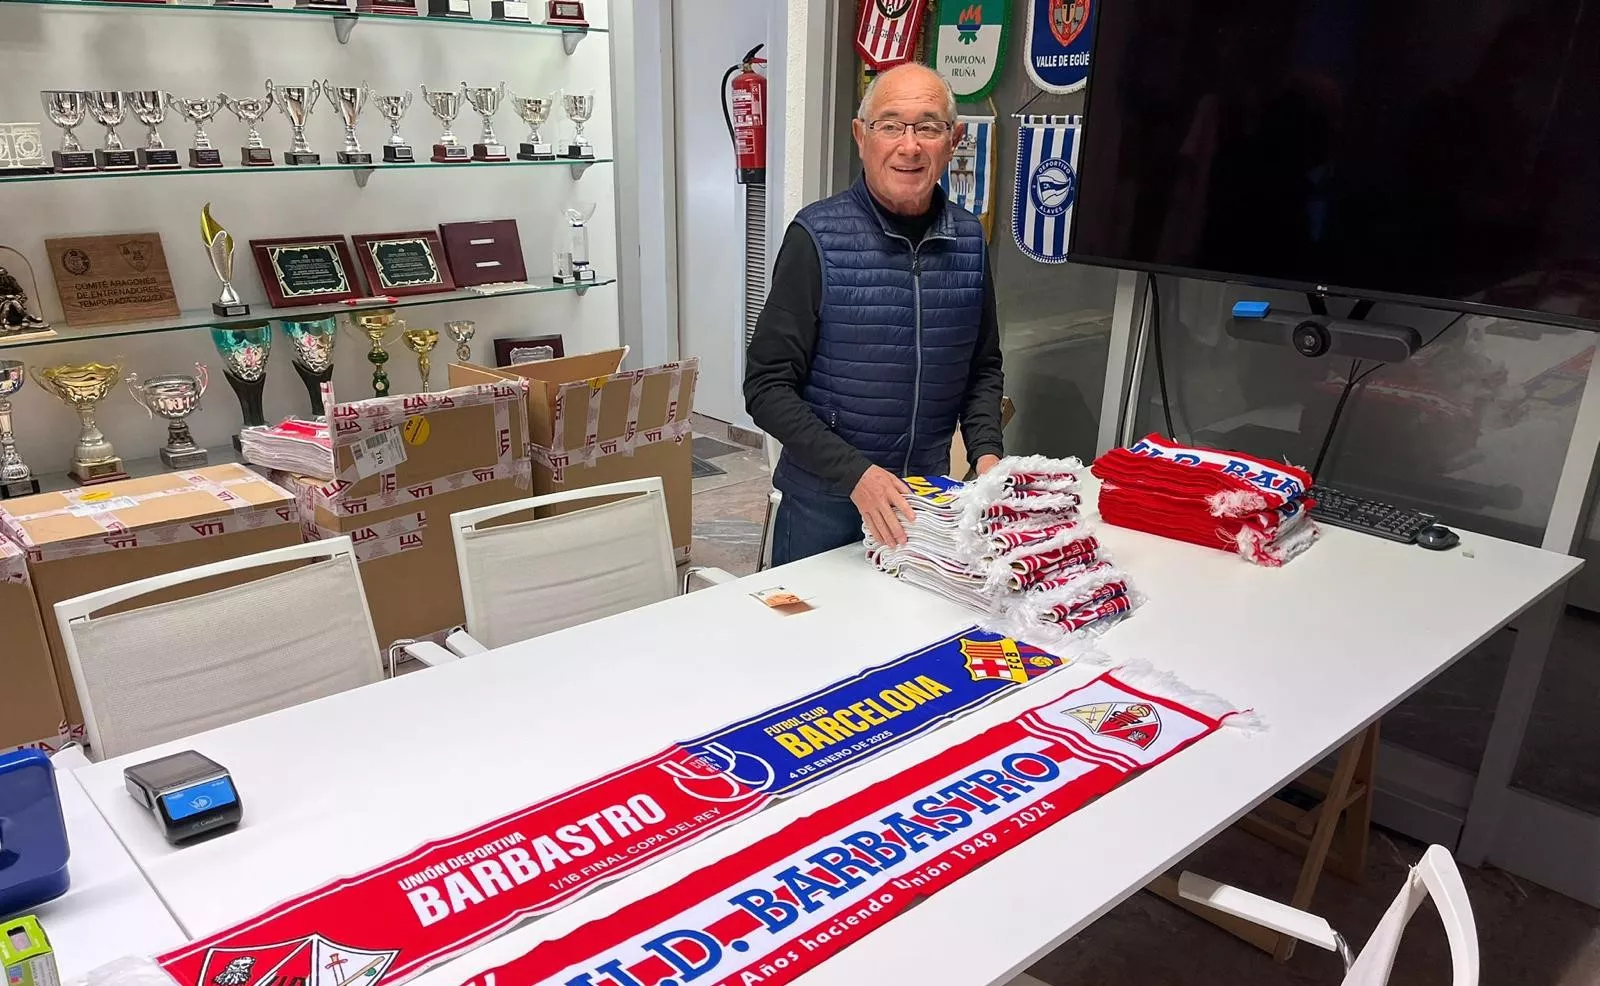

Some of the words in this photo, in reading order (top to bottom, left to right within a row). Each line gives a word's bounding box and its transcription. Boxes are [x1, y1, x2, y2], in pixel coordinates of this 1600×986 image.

[944, 55, 986, 65] PAMPLONA
[951, 66, 976, 78] IRUÑA
[1036, 55, 1057, 68] VALLE
[1058, 54, 1068, 67] DE
[1038, 160, 1071, 174] DEPORTIVO
[76, 291, 90, 300] DE
[1005, 651, 1024, 671] FCB
[763, 715, 805, 736] FUTBOL
[800, 706, 829, 721] CLUB
[774, 674, 953, 759] BARCELONA
[788, 771, 799, 780] 4
[799, 763, 814, 775] DE
[814, 748, 852, 768] ENERO
[853, 740, 868, 752] DE
[867, 730, 893, 745] 2025
[398, 863, 450, 892] UNIÓN
[449, 831, 527, 871] DEPORTIVA
[406, 793, 667, 928] BARBASTRO
[549, 872, 582, 891] 1/16
[583, 853, 628, 878] FINAL
[627, 834, 668, 855] COPA
[668, 821, 694, 838] DEL
[695, 807, 722, 824] REY
[727, 752, 1060, 935] BARBASTRO
[738, 950, 799, 986] Años
[799, 891, 894, 952] haciendo
[892, 861, 952, 890] Unión
[951, 832, 998, 860] 1949
[1013, 800, 1056, 829] 2024
